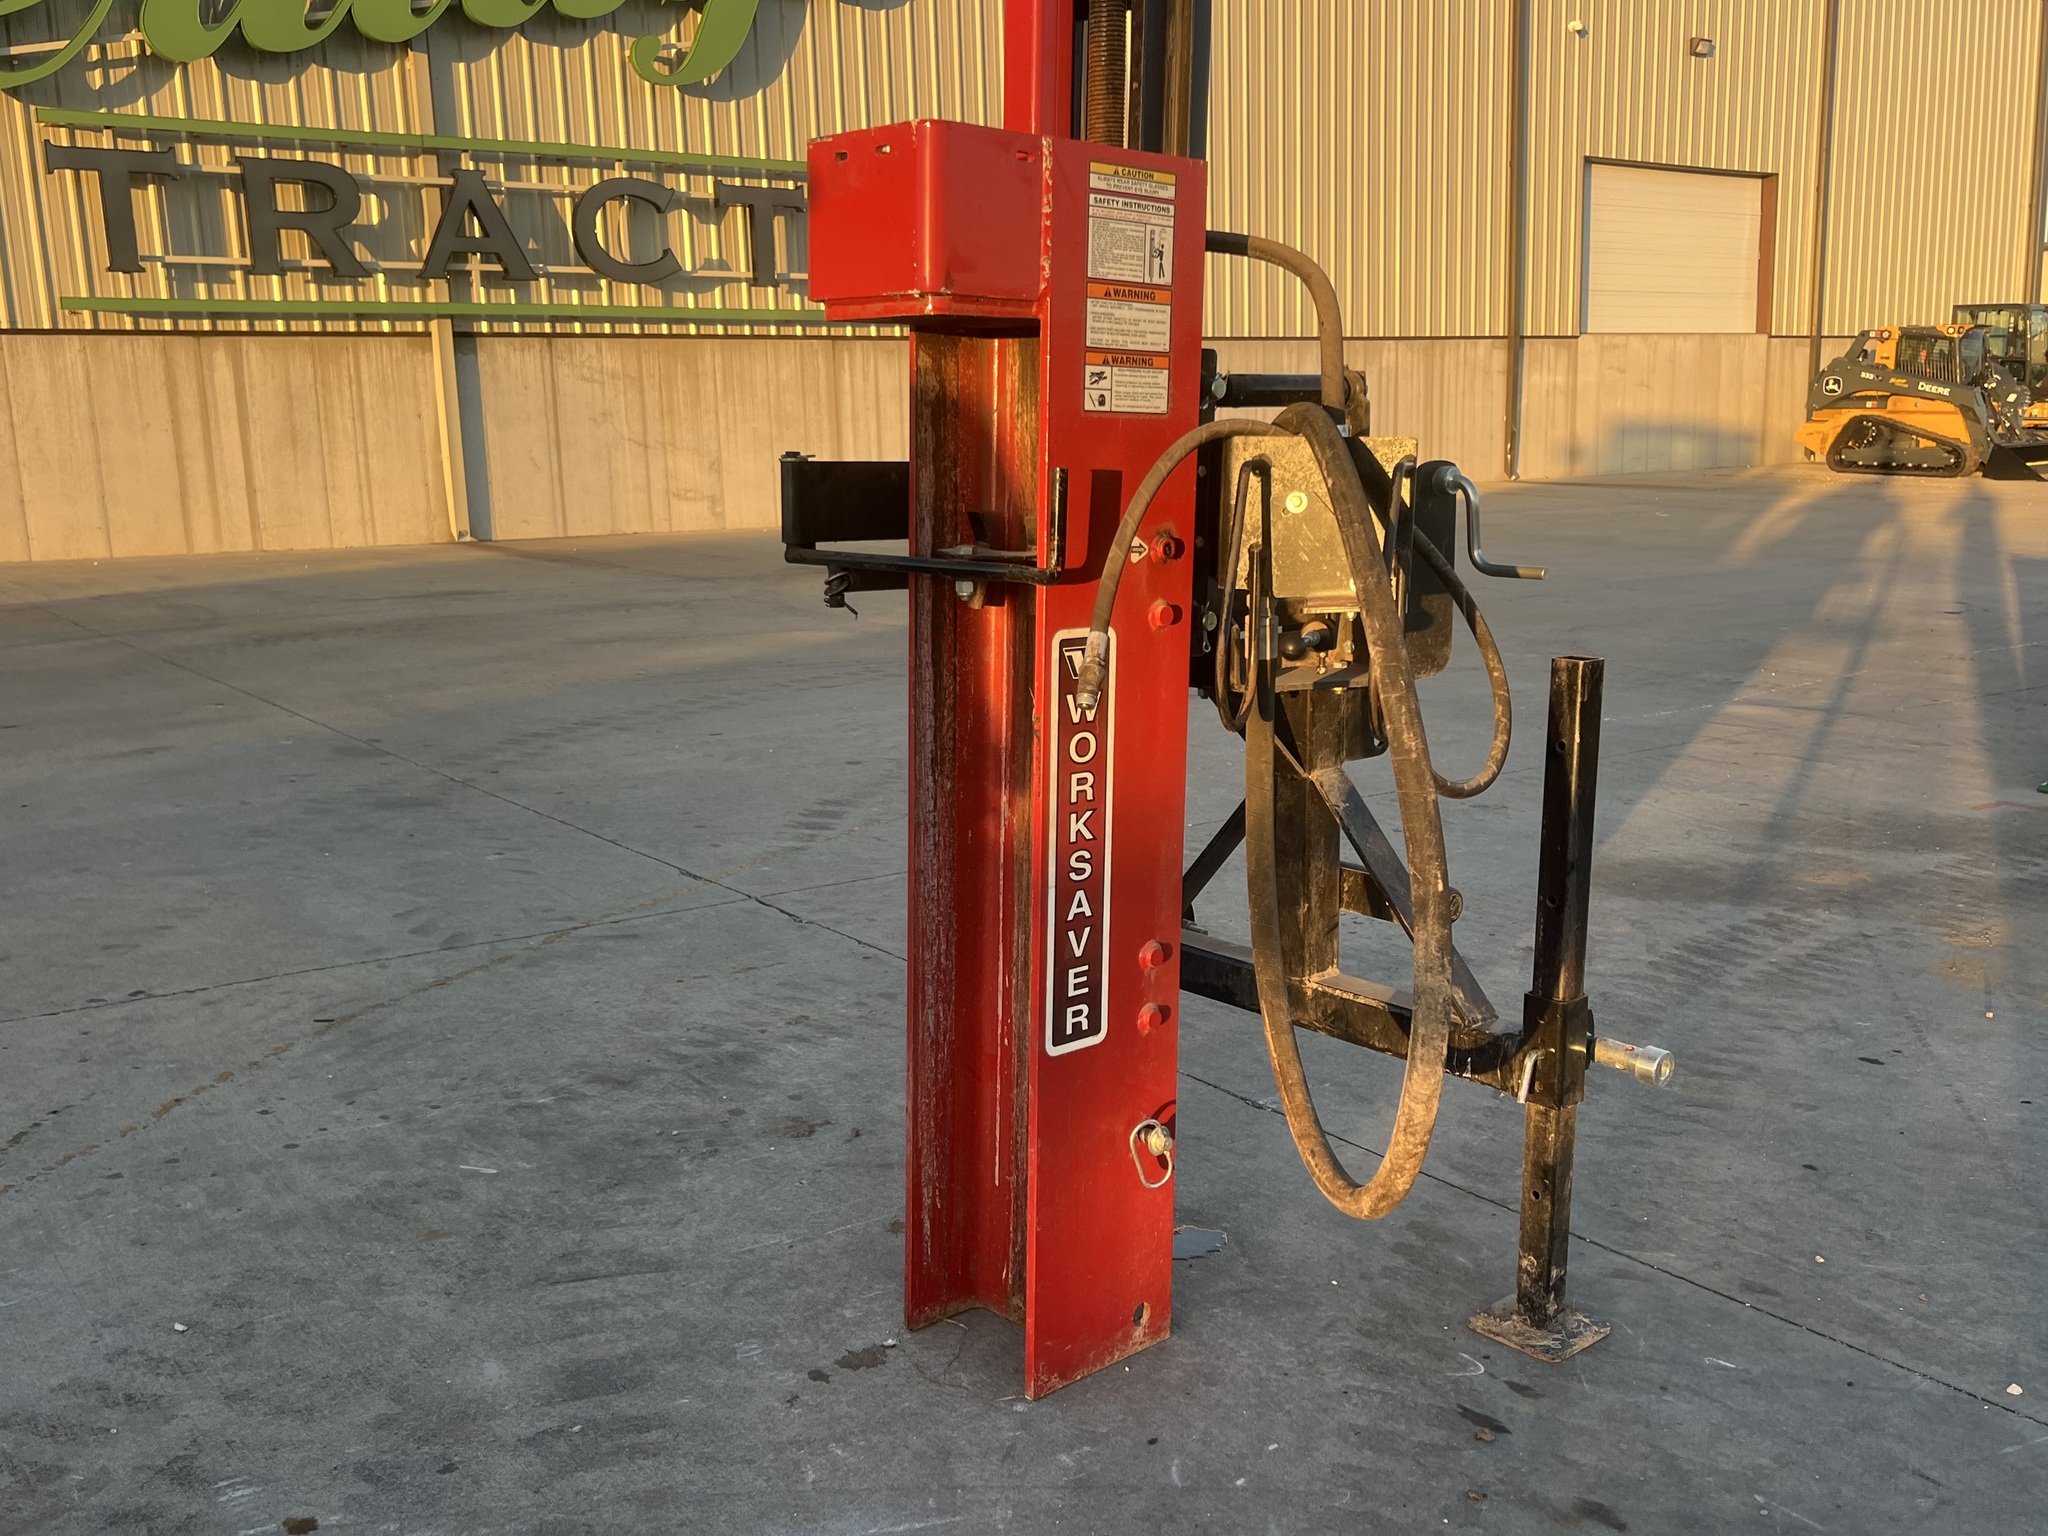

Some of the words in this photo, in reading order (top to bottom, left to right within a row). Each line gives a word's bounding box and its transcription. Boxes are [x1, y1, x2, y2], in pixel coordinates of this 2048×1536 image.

[1121, 168, 1154, 180] CAUTION
[1097, 176, 1116, 184] ALWAYS
[1131, 180, 1147, 188] SAFETY
[1148, 183, 1169, 191] GLASSES
[1113, 184, 1134, 192] PREVENT
[1094, 196, 1120, 206] SAFETY
[1121, 200, 1171, 214] INSTRUCTIONS
[1112, 288, 1156, 301] WARNING
[1111, 355, 1154, 367] WARNING
[1917, 381, 1951, 397] DEERE
[1065, 691, 1101, 1036] WORKSAVER
